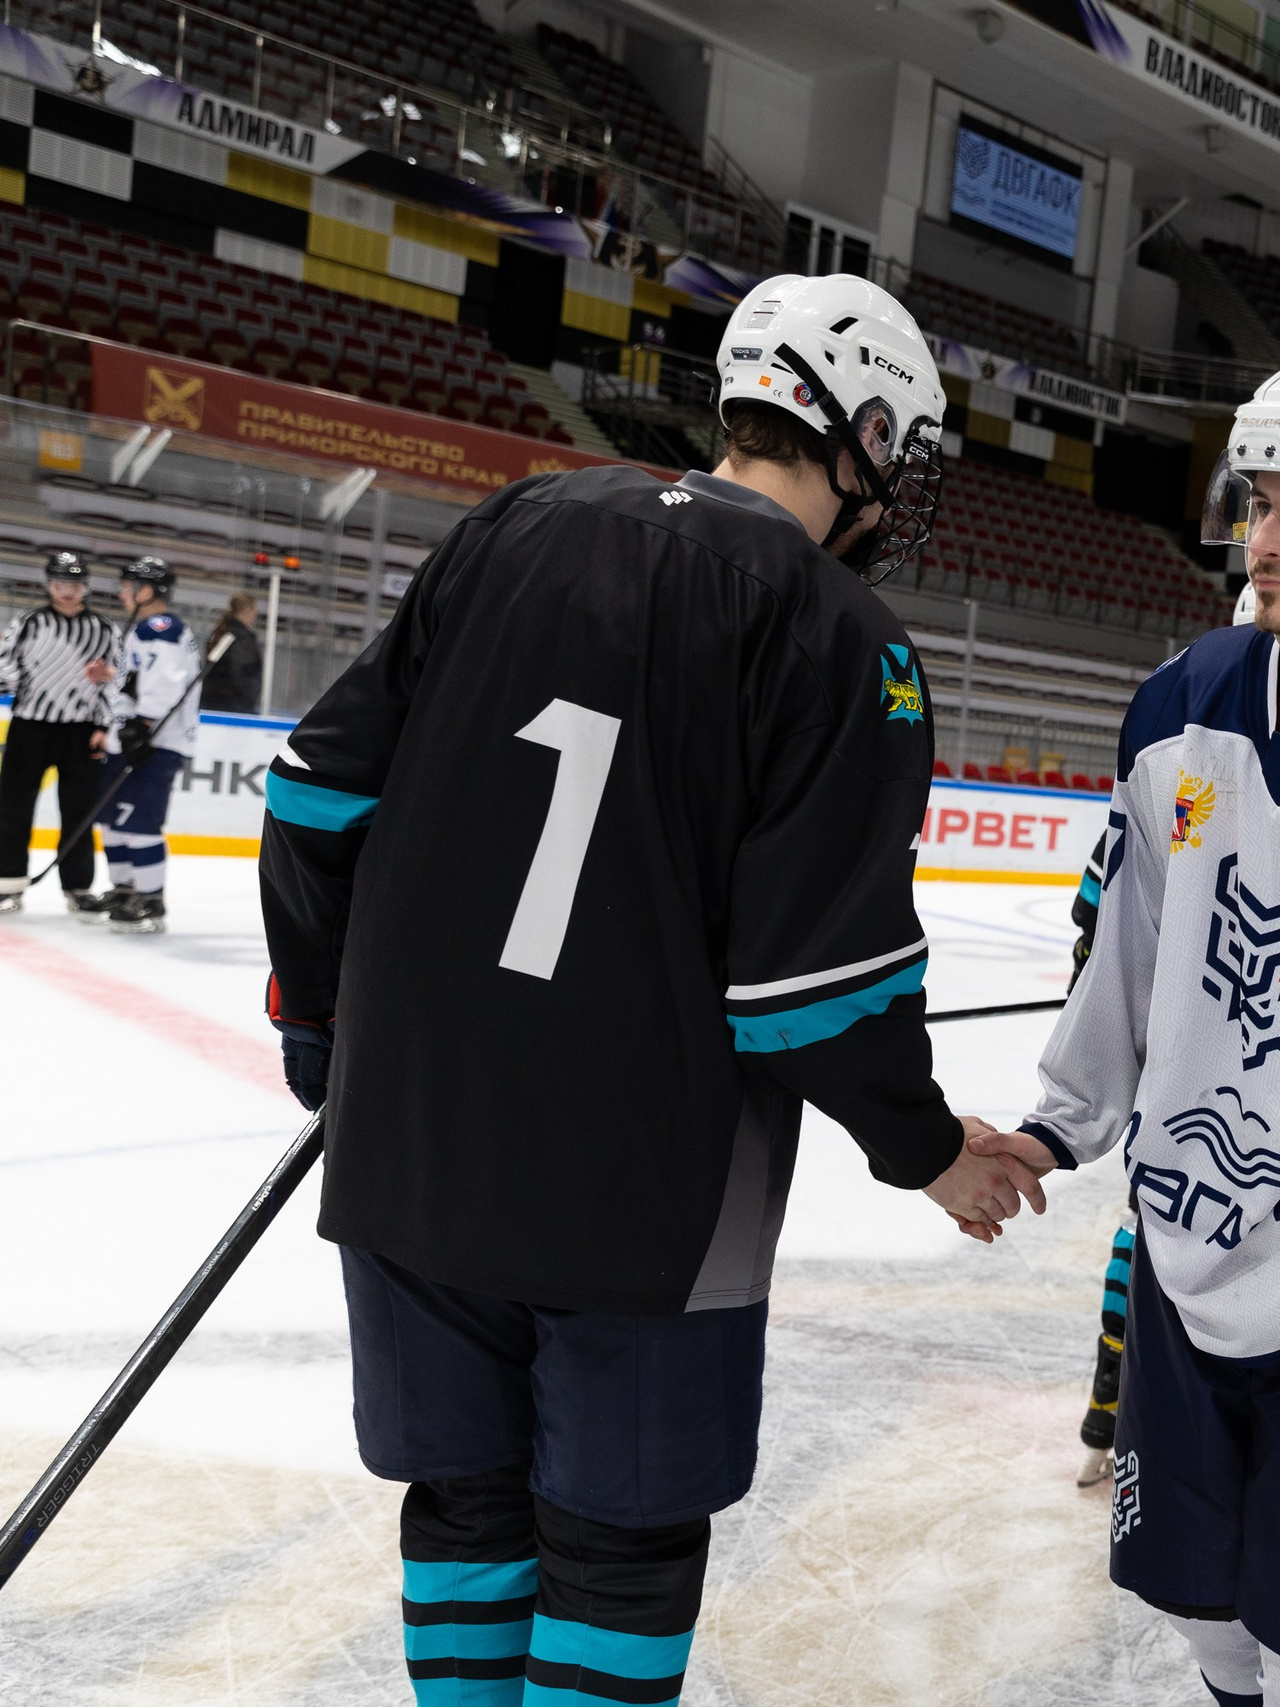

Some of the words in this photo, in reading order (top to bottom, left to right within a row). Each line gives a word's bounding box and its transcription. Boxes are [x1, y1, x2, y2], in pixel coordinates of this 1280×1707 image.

[178, 92, 316, 164] АДМИРАЛ
[873, 355, 915, 385] CCM
[238, 420, 438, 475] ПРИМОРСКОГО
[240, 400, 465, 462] ПРАВИТЕЛЬСТВО
[910, 446, 929, 461] CCM
[115, 802, 135, 826] 7
[499, 698, 622, 981] 1
